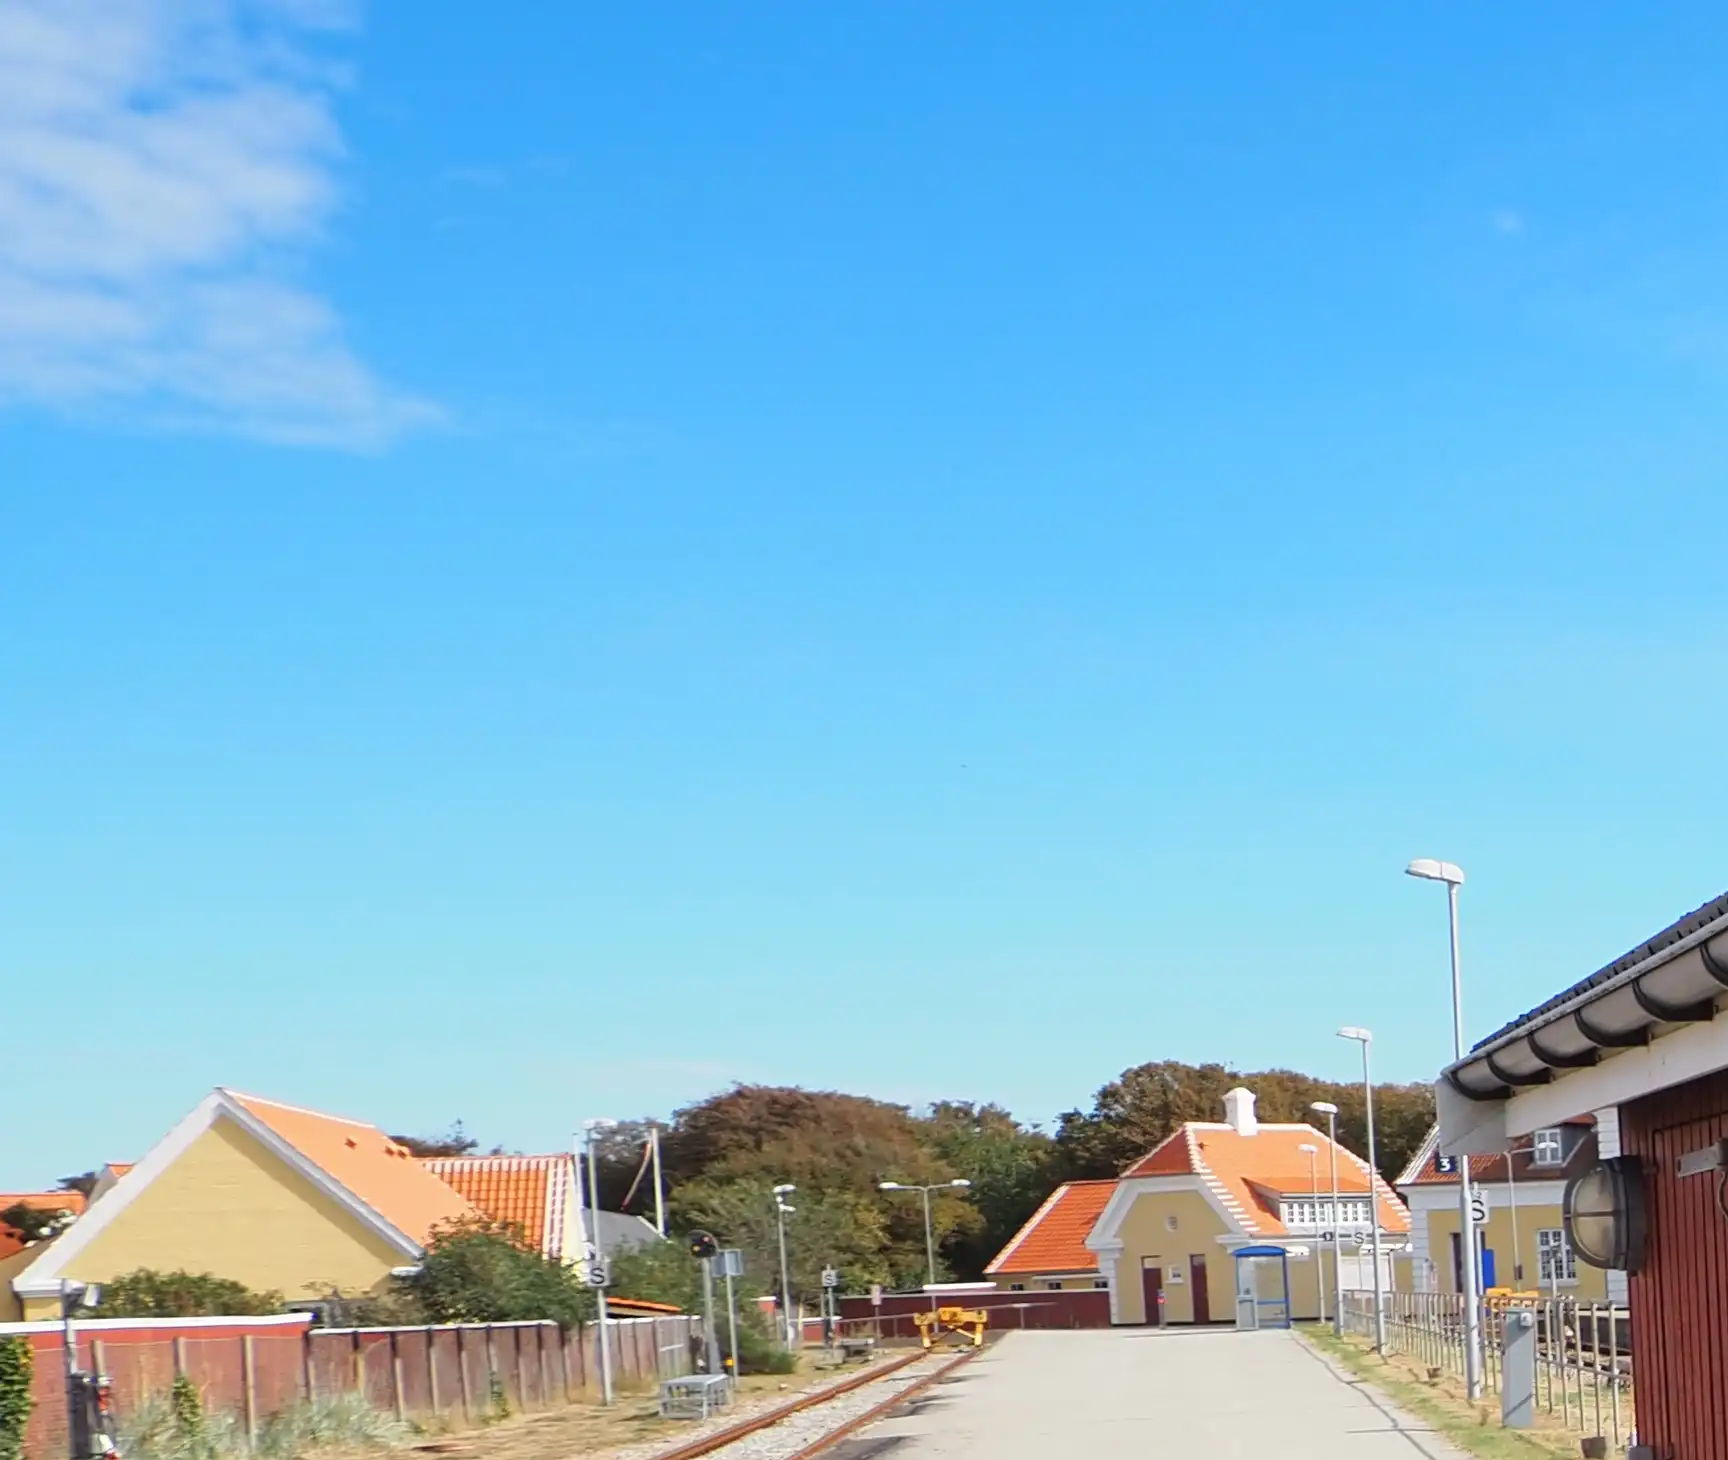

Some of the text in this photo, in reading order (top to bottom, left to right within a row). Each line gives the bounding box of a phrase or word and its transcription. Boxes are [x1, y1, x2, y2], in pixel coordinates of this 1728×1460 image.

[1440, 1158, 1451, 1172] 3
[1355, 1232, 1364, 1244] S
[591, 1267, 604, 1284] S
[824, 1274, 833, 1285] S
